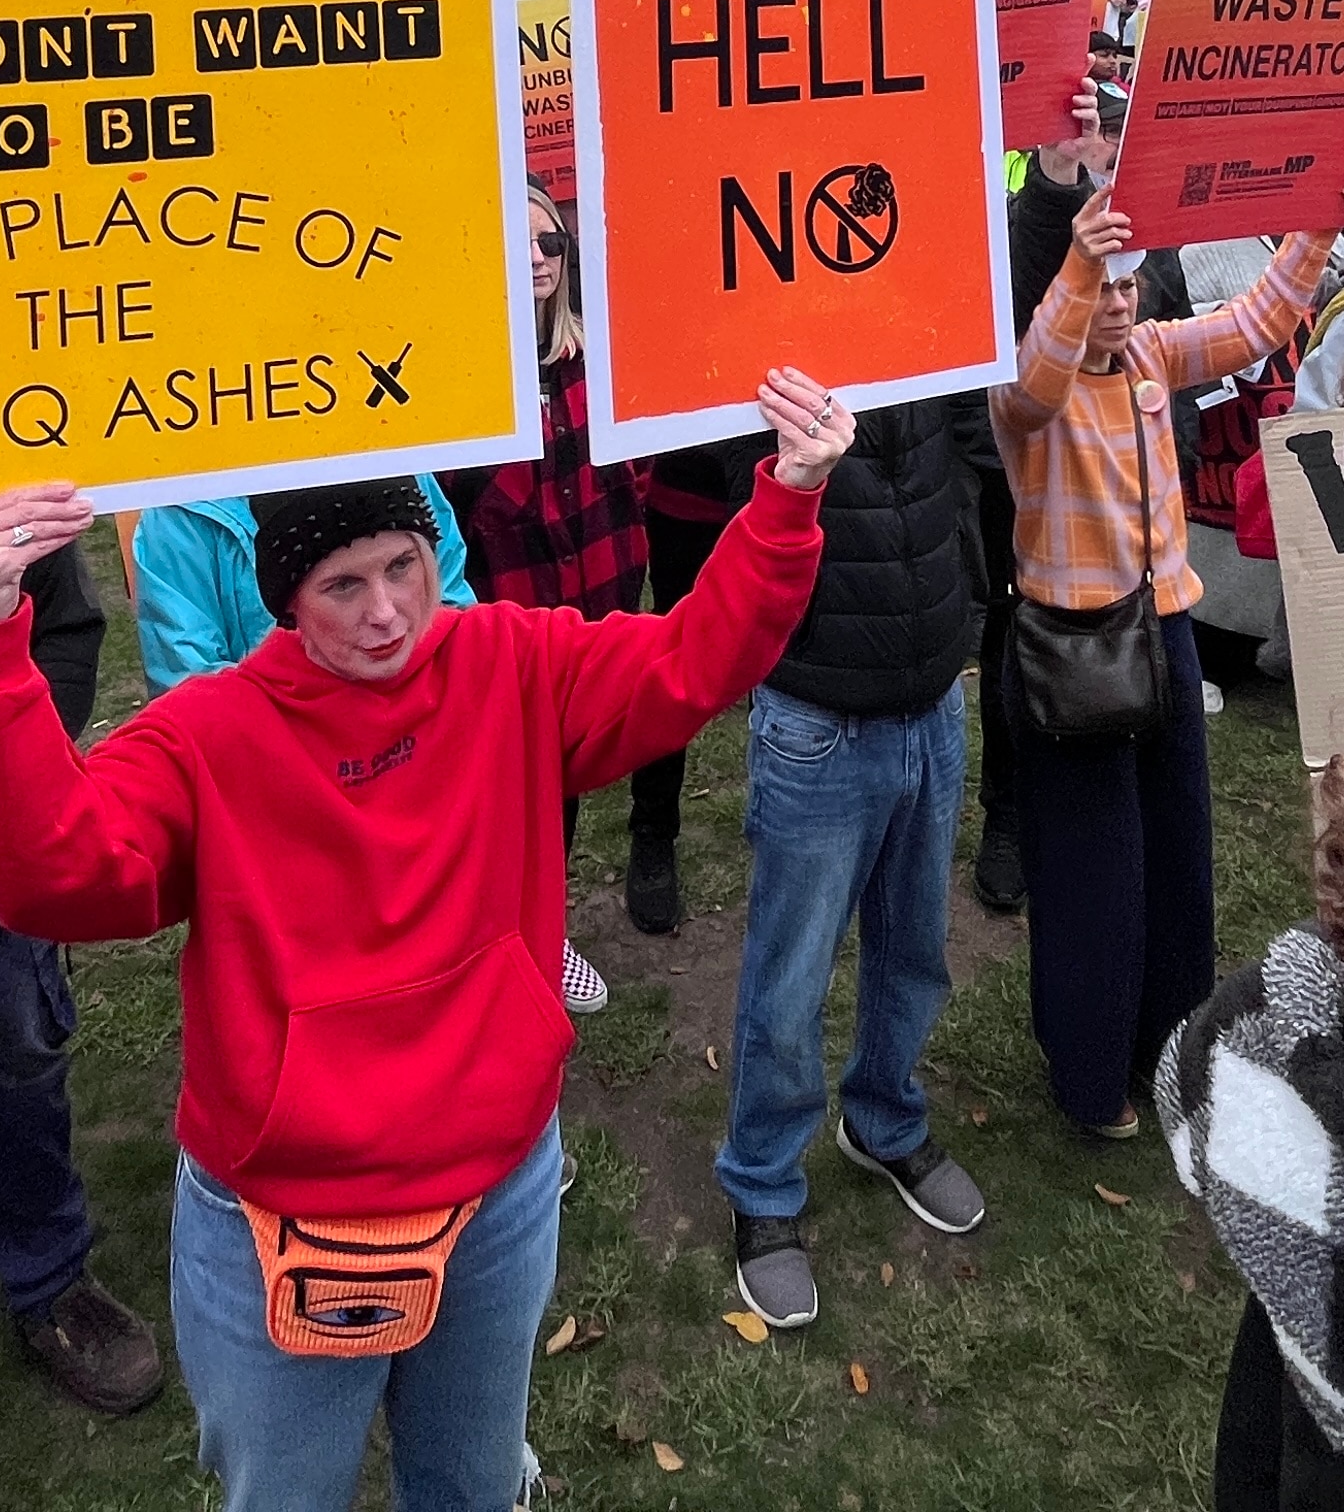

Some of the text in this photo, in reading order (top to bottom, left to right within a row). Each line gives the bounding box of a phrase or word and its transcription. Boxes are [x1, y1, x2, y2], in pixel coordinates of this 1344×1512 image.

[200, 6, 427, 60] WANT
[101, 100, 197, 151] BE
[523, 94, 573, 117] WAS
[1284, 155, 1315, 174] MP
[295, 209, 403, 280] OF
[16, 281, 154, 349] THE
[106, 354, 338, 439] ASHES
